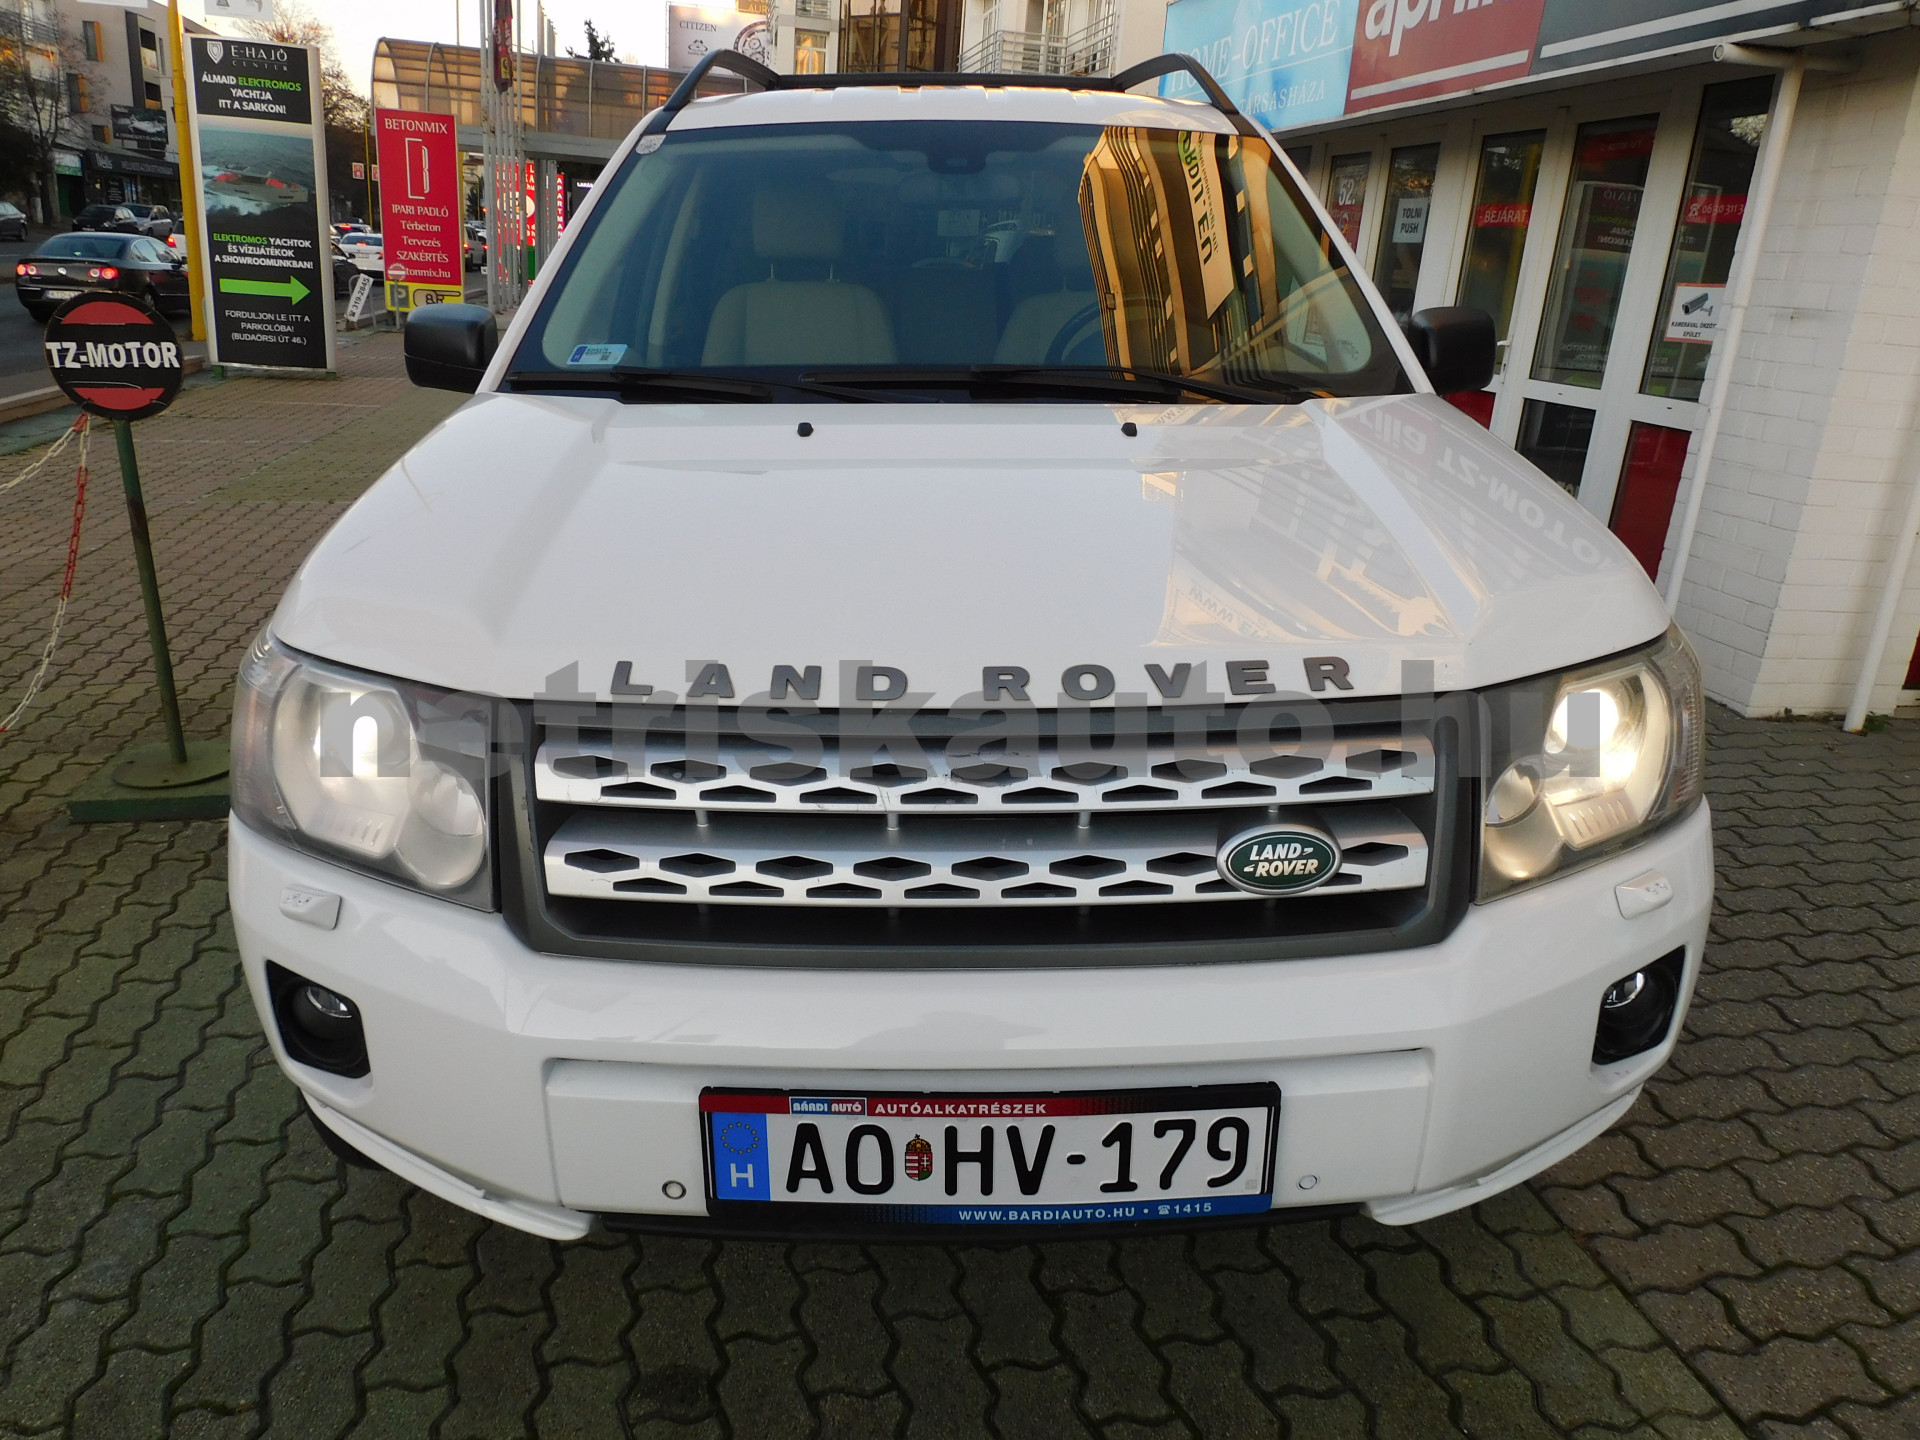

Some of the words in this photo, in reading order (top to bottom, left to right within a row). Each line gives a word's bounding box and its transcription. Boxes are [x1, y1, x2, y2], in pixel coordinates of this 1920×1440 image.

[680, 20, 717, 32] CITIZEN
[202, 71, 236, 85] ÁLMAID
[238, 76, 302, 92] ELEKTROMOS
[230, 88, 273, 101] YACHTJA
[219, 99, 232, 109] ITT
[233, 102, 241, 110] A
[242, 102, 287, 114] SARKON!
[385, 118, 448, 134] BETONMIX
[392, 204, 415, 214] IPARI
[417, 205, 449, 217] PADLÓ
[1402, 207, 1422, 218] TOLNI
[1484, 208, 1528, 223] BEJÁRAT
[400, 220, 441, 232] Térbeton
[1401, 222, 1418, 234] PUSH
[213, 232, 268, 245] ELEKTROMOS
[268, 237, 312, 248] YACHTOK
[402, 235, 441, 247] Tervezés
[228, 243, 238, 253] ÉS
[214, 254, 221, 262] A
[222, 255, 314, 269] SHOWROOMUNKBAN!
[396, 250, 449, 263] SZAKÉRTÉS
[225, 309, 275, 321] FORDULJON
[276, 313, 287, 321] LE
[288, 314, 302, 322] ITT
[241, 321, 294, 332] PARKOLÓBA!
[279, 335, 290, 343] ÚT
[45, 341, 180, 369] TZ-MOTOR
[610, 661, 909, 700] LAND
[982, 656, 1354, 701] ROVER
[1250, 843, 1302, 861] LAND
[1255, 859, 1319, 877] ROVER
[793, 1101, 829, 1113] BÁRDI
[831, 1101, 863, 1113] AUTÓ
[874, 1101, 1047, 1115] AUTÓALKATRÉSZEK
[786, 1122, 895, 1196] AO
[944, 1116, 1250, 1197] HV-179
[730, 1163, 754, 1188] H
[958, 1206, 1136, 1222] WWW.BARDIAUTO.HU
[1174, 1202, 1213, 1214] 1415
